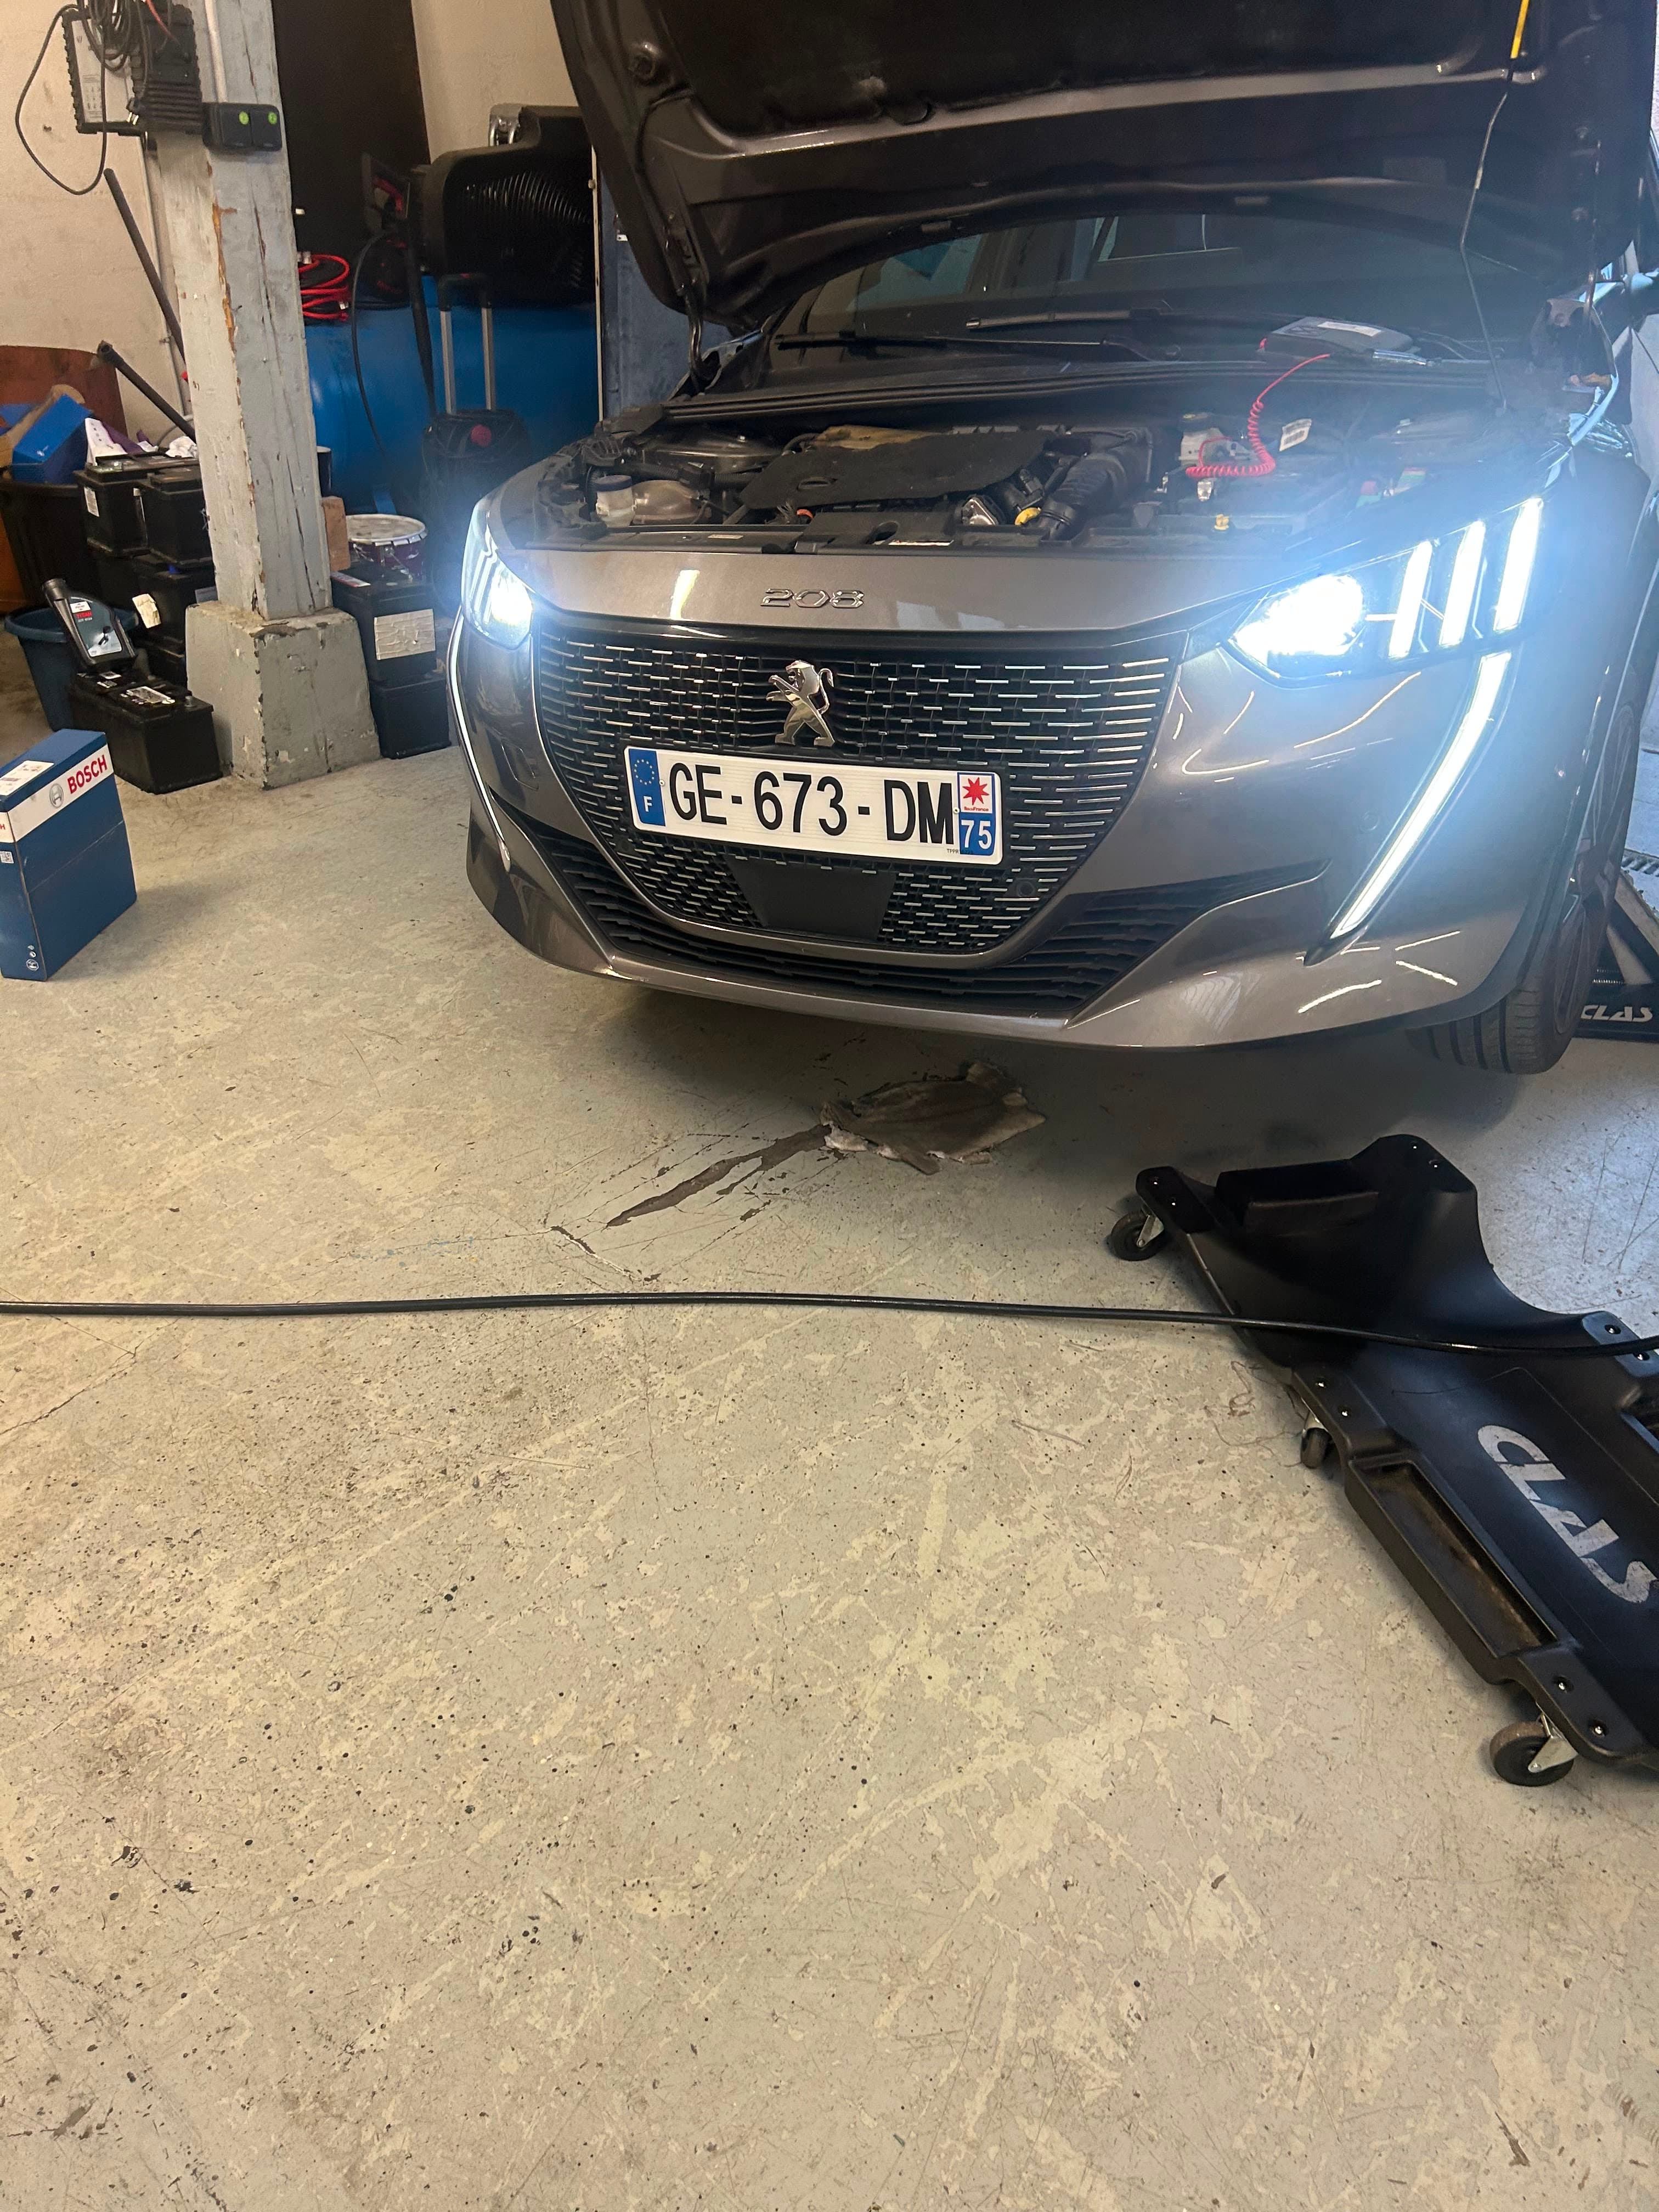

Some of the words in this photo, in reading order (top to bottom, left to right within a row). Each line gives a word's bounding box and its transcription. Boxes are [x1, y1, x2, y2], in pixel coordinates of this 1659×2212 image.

[760, 589, 864, 608] 208
[67, 754, 108, 794] BOSCH
[643, 796, 652, 812] F
[961, 820, 992, 849] 75
[1581, 1005, 1653, 1022] CLAS
[1478, 1425, 1658, 1603] CLAS
